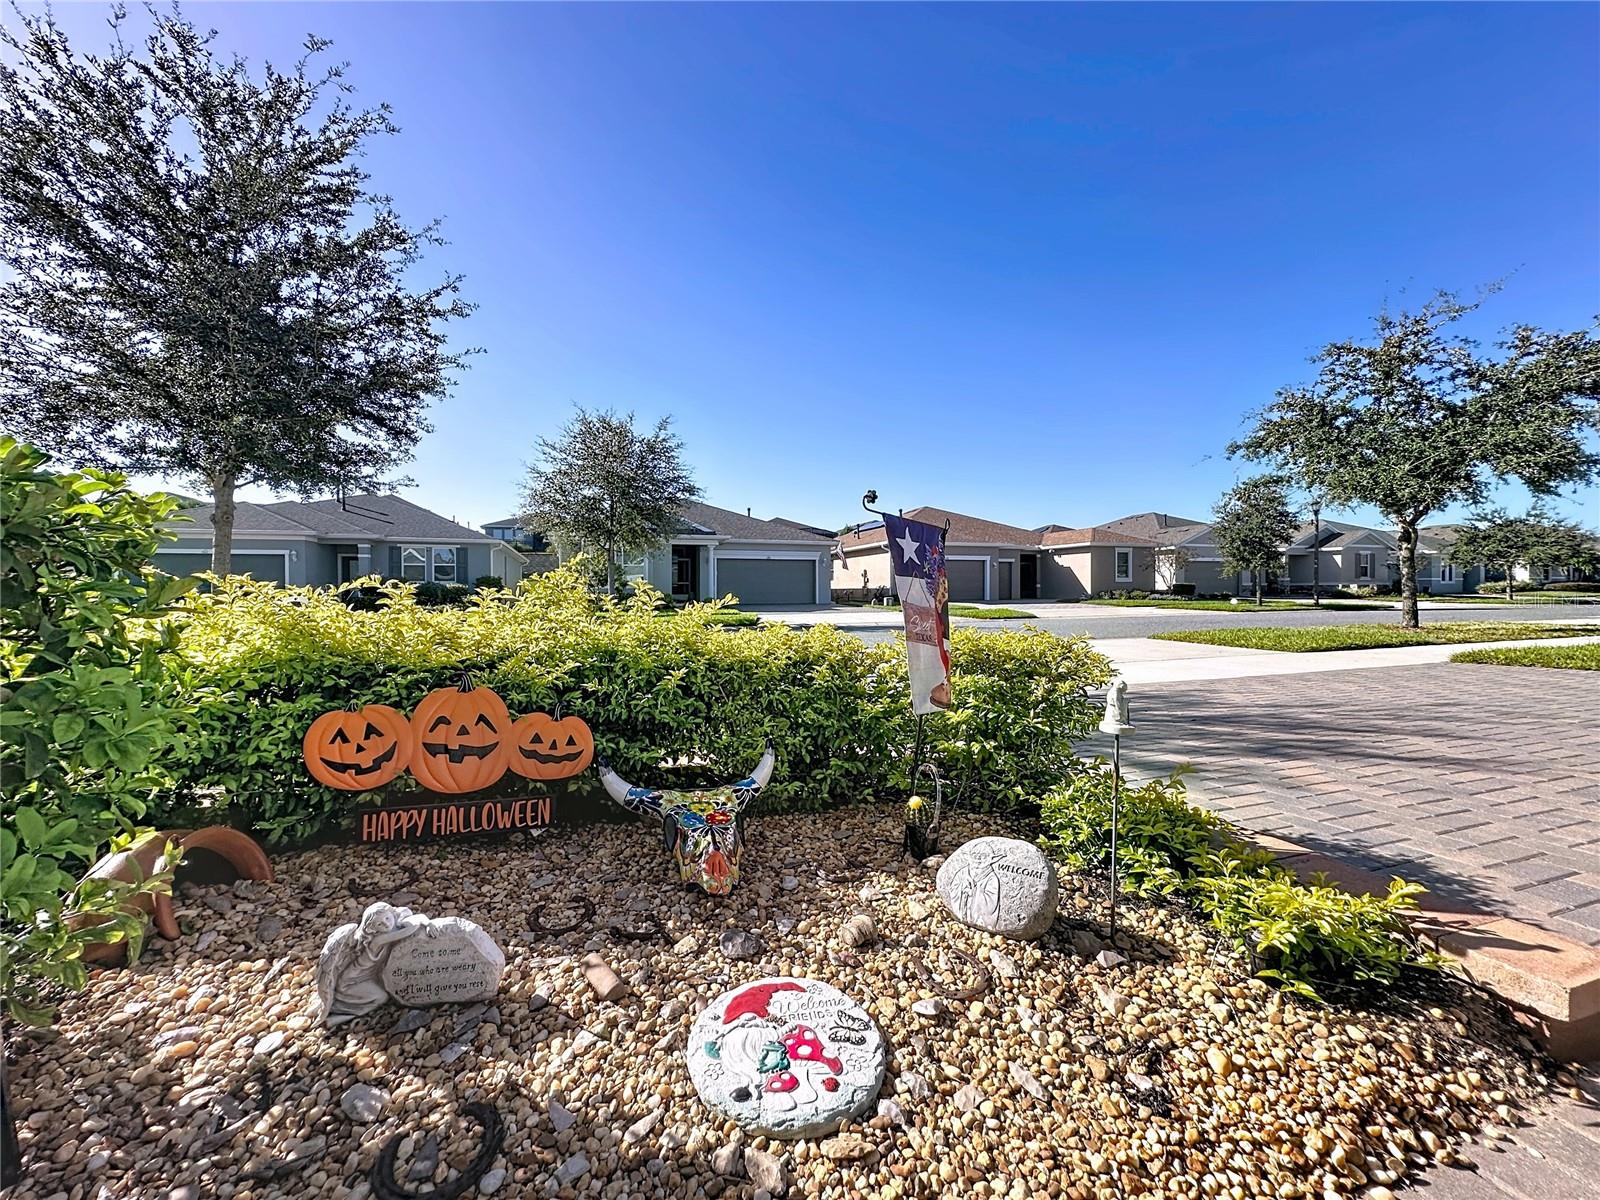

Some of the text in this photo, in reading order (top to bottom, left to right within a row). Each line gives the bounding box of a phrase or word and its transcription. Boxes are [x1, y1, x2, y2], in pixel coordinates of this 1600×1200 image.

[362, 798, 551, 842] HAPPY HALLOWEEN
[997, 863, 1044, 880] WELCOME
[412, 948, 435, 959] Come
[450, 947, 462, 957] me
[391, 968, 402, 977] all
[420, 964, 434, 975] who
[452, 963, 476, 973] weary
[415, 983, 432, 994] will
[434, 985, 453, 996] give
[453, 983, 467, 993] you
[772, 995, 846, 1014] Welcome
[780, 1009, 834, 1022] FRIENDS
